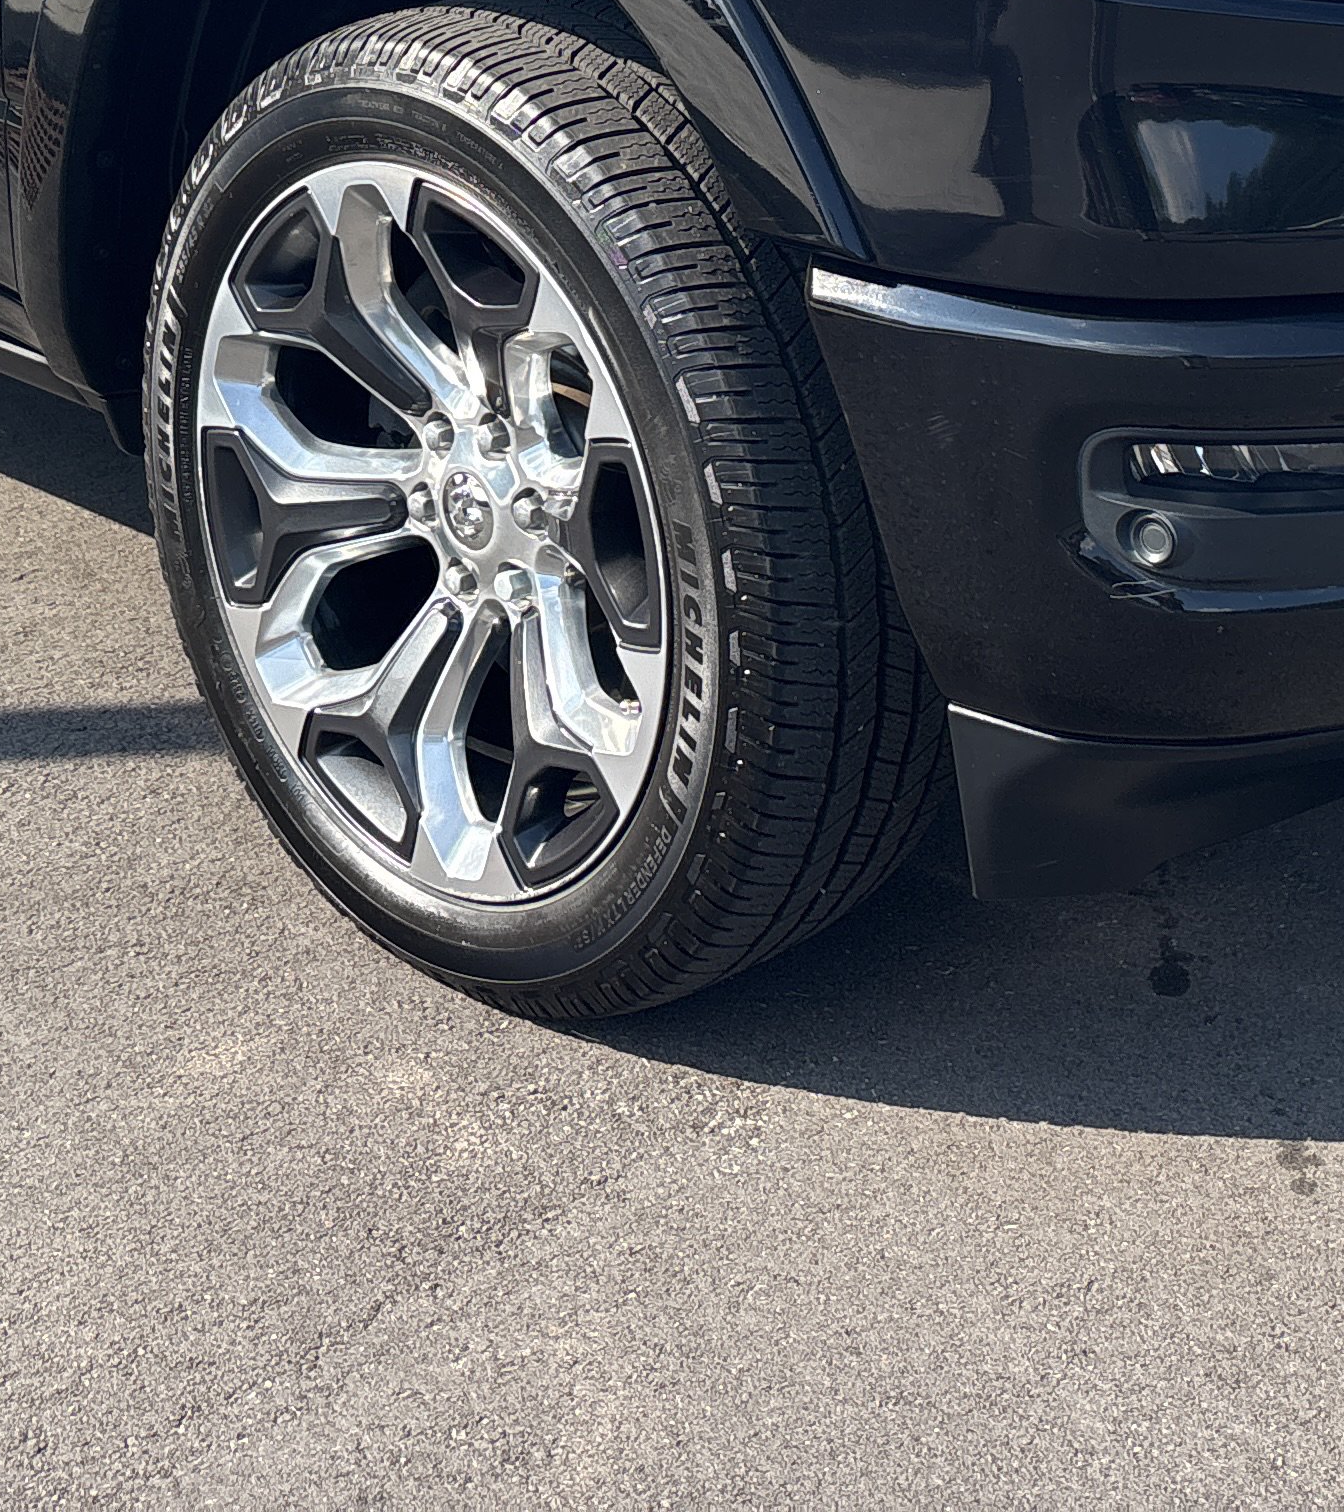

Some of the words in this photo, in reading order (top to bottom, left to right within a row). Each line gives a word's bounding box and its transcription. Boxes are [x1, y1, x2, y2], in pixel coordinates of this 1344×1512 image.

[157, 321, 183, 541] MICHELIN
[672, 519, 704, 789] MICHELIN
[623, 824, 672, 905] DEFENDER
